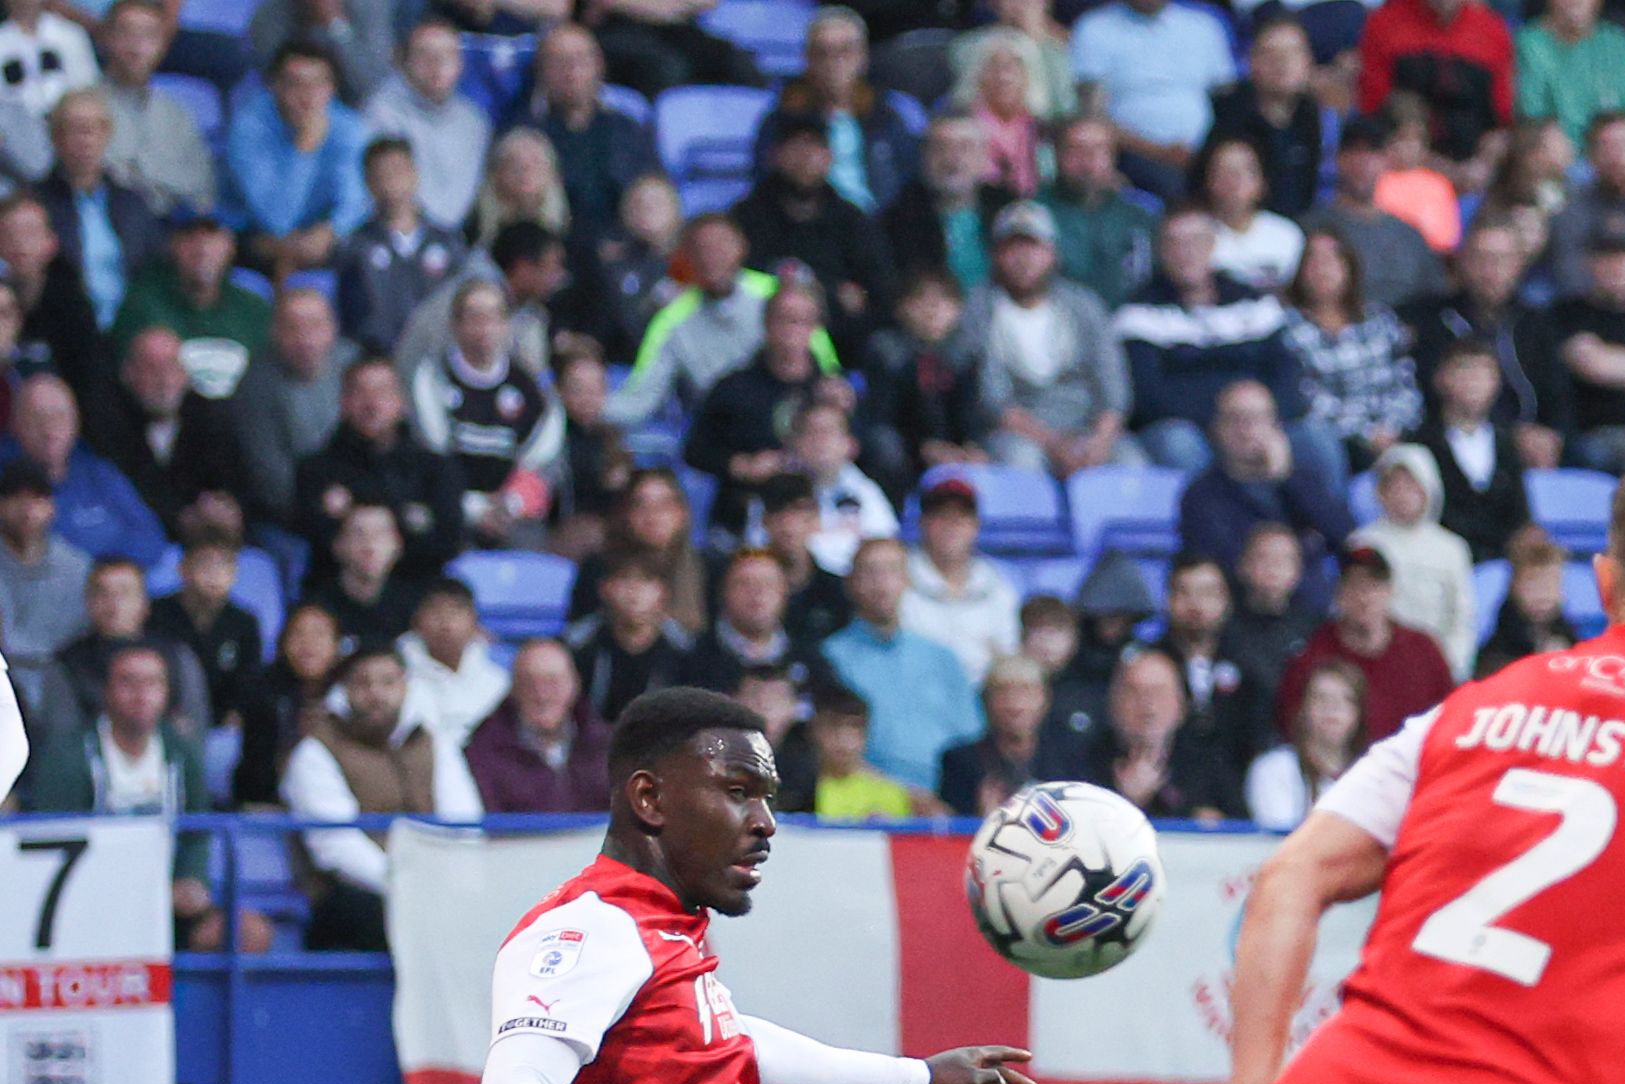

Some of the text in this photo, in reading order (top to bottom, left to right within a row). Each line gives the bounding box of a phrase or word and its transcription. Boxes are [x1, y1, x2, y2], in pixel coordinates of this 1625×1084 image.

[19, 840, 89, 948] 7
[1411, 767, 1618, 987] 2
[39, 963, 149, 1006] TOUR
[499, 1017, 566, 1033] TOGETHER
